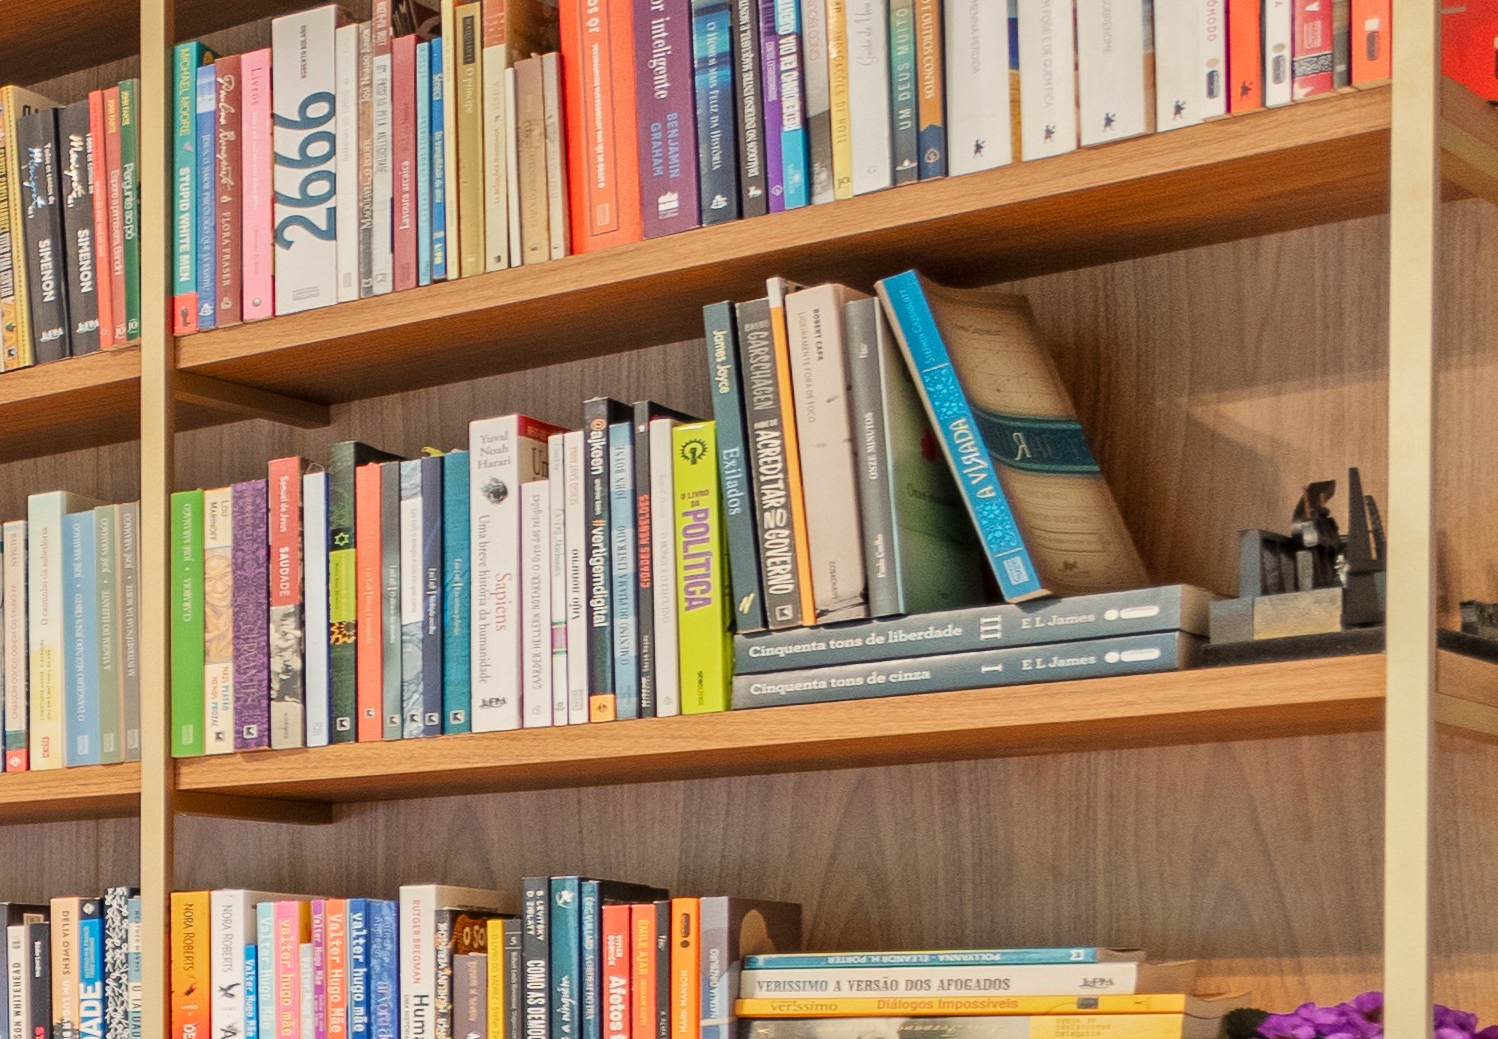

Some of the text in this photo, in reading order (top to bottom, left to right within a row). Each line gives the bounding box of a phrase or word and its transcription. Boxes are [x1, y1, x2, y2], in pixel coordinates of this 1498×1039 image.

[647, 17, 672, 101] inteligente
[274, 91, 336, 250] 2666
[650, 122, 663, 177] GRAHAM
[665, 112, 681, 179] BENJAMIN
[178, 167, 191, 282] STUPID WHITE MEN
[38, 239, 54, 302] SIMENON
[77, 228, 93, 292] SIMENON
[713, 330, 731, 395] James Joyce
[747, 324, 774, 411] GARSCHAGEN
[477, 456, 511, 469] Harari
[479, 431, 509, 443] Yuval
[481, 444, 510, 457] Noah
[755, 429, 786, 508] ACREDITAR
[723, 446, 744, 516] Exilados
[682, 507, 712, 611] POLÍTICA
[764, 530, 795, 595] GOVERNO
[492, 572, 512, 632] Sapiens
[1021, 611, 1096, 630] E L James
[748, 641, 826, 660] Cinquenta
[828, 638, 862, 652] tons
[865, 631, 885, 647] de
[887, 625, 962, 643] liberdade
[1021, 652, 1096, 671] E L James
[750, 677, 828, 697] Cinquenta
[830, 675, 864, 688] tons
[866, 671, 886, 685] de
[888, 669, 931, 683] cinza
[757, 976, 1011, 992] VERISSIMO A VERSÃO DOS AFOGADOS
[877, 997, 1018, 1012] Diálogos Impossíveis
